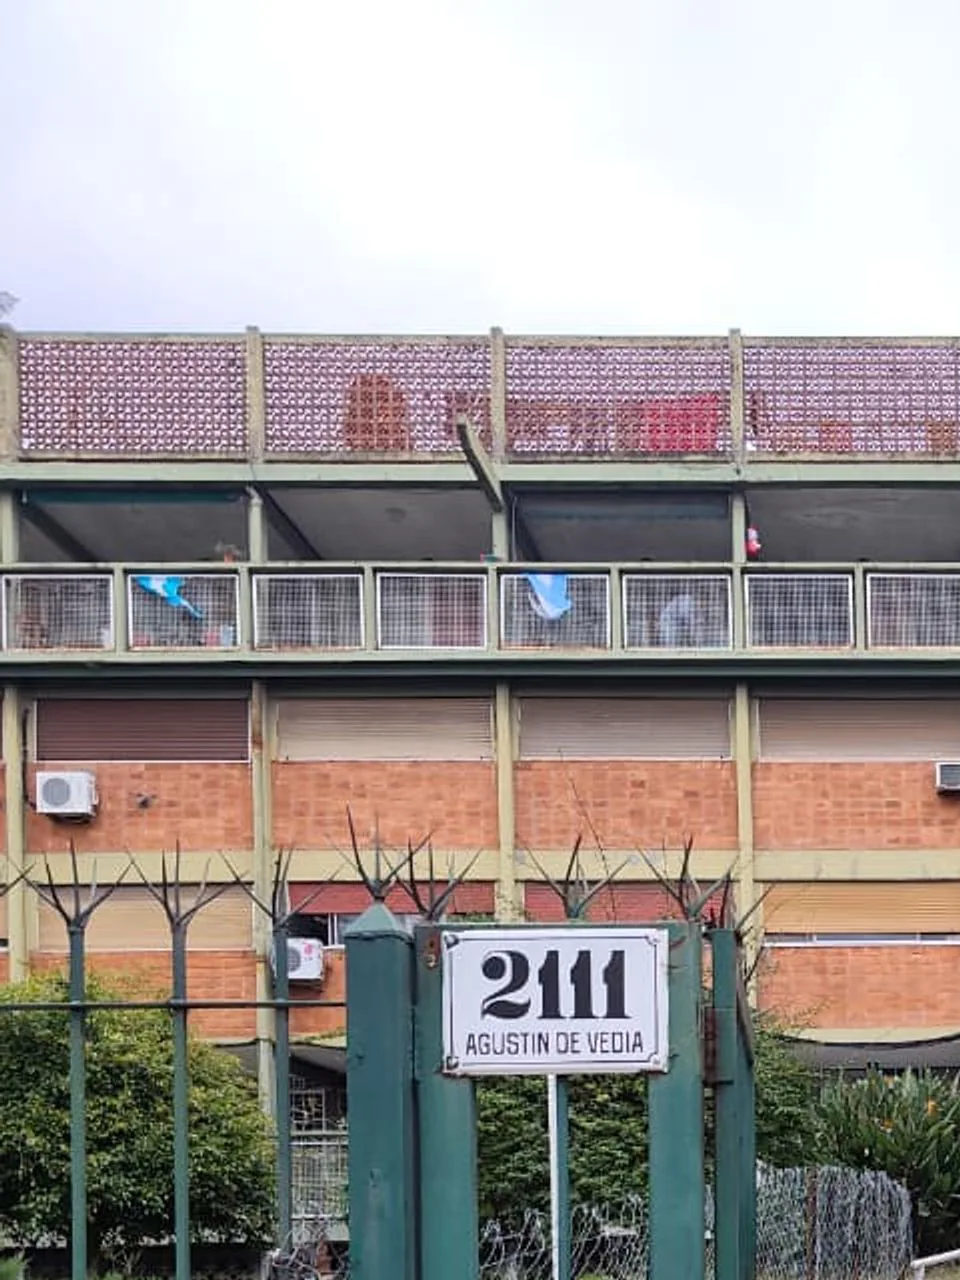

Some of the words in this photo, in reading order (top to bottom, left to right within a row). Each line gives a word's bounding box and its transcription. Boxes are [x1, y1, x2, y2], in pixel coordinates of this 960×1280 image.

[481, 949, 632, 1020] 2111
[465, 1032, 549, 1056] AGUSTIN
[556, 1031, 580, 1054] DE
[587, 1031, 644, 1053] VEDIA
